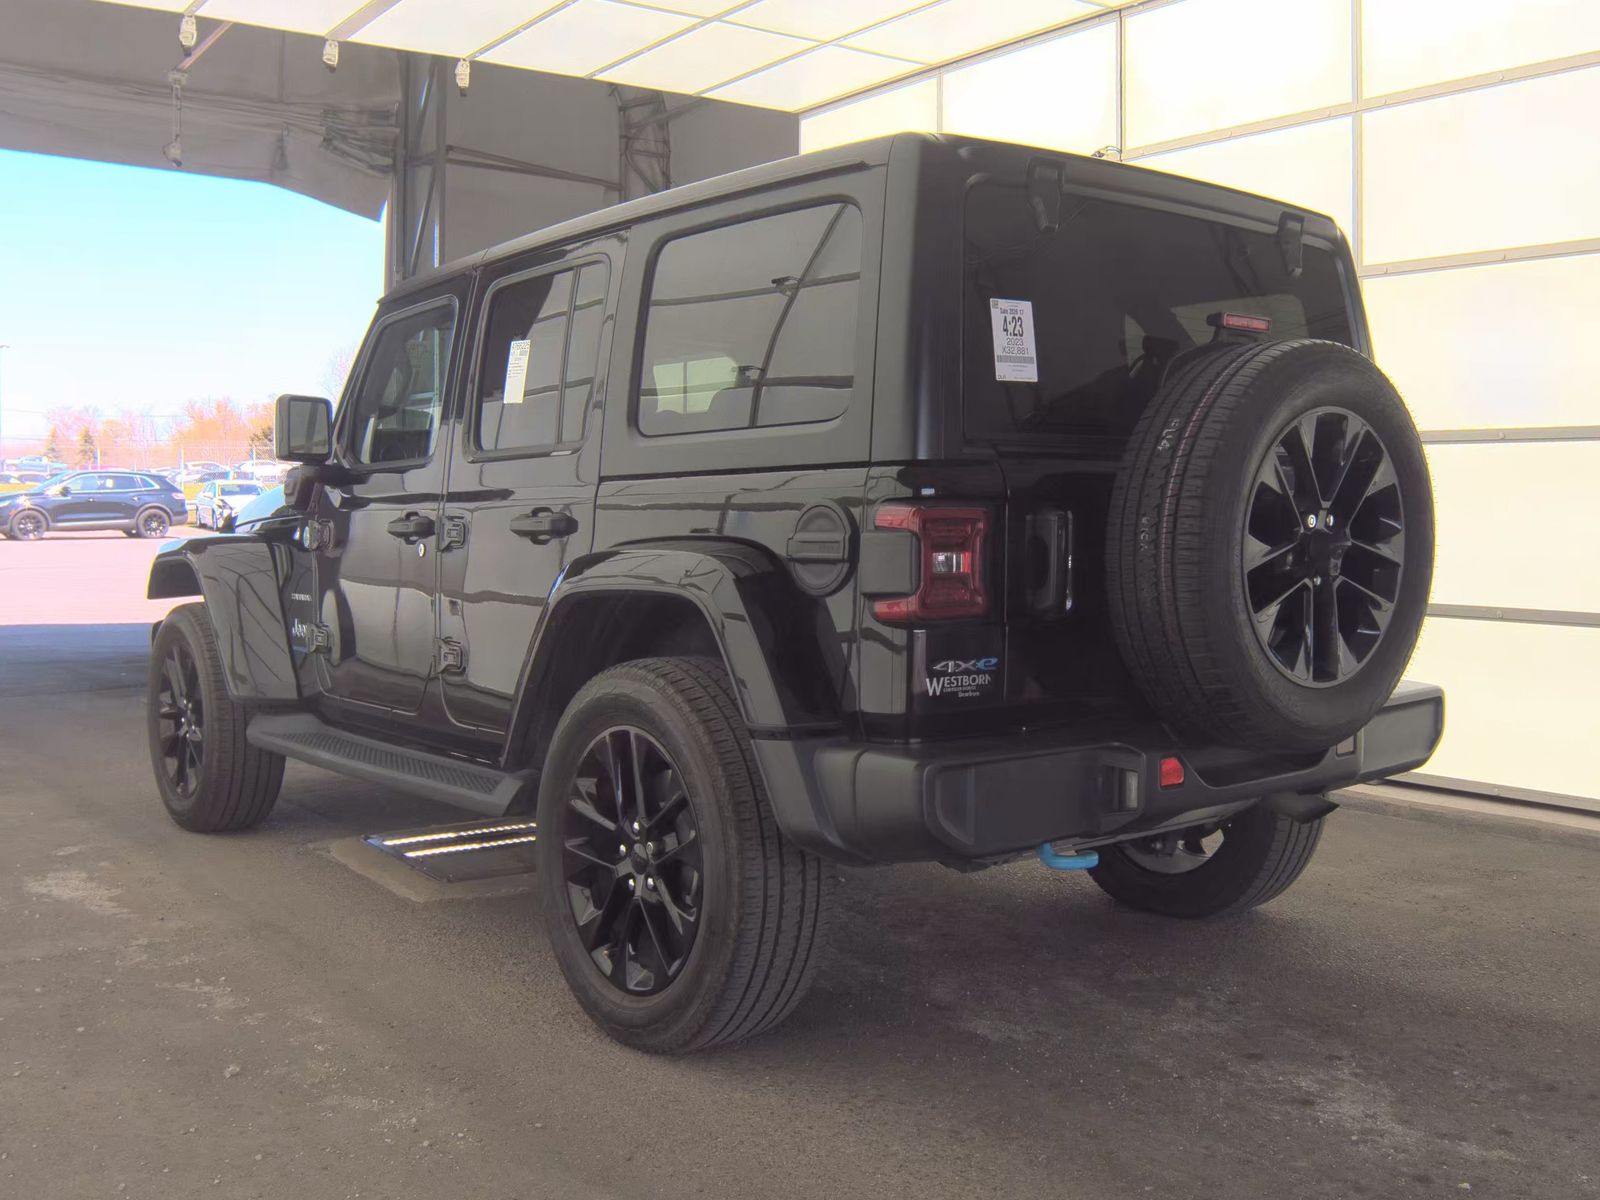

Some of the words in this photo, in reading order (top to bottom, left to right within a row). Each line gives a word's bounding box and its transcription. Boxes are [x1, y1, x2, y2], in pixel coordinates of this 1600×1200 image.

[1003, 315, 1023, 337] 4:23
[1006, 337, 1024, 346] 2023
[292, 618, 308, 638] Jee
[926, 674, 991, 696] WESTBORN
